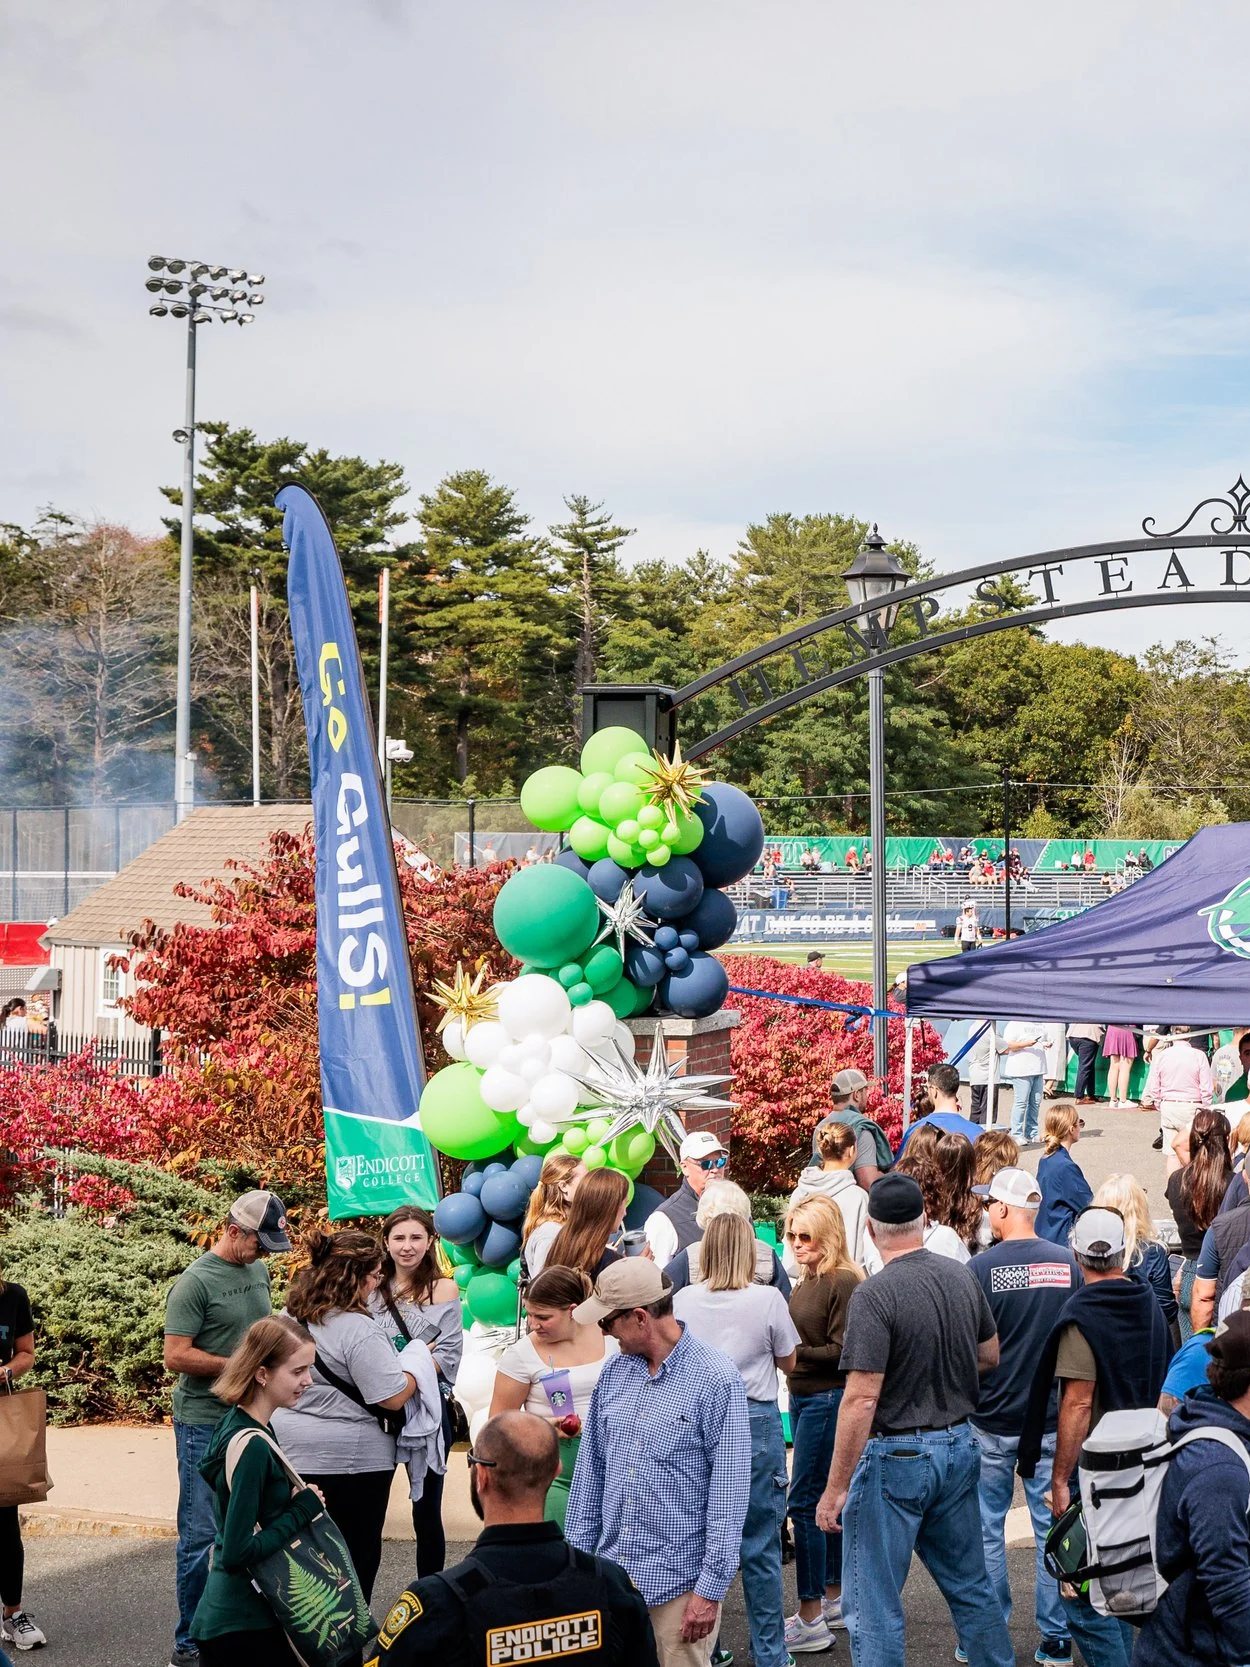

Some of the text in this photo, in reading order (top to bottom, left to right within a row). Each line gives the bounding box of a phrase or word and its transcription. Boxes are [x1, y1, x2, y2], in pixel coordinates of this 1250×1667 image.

[356, 1154, 425, 1176] ENDICOTT
[363, 1173, 420, 1187] COLLEGE
[491, 1614, 597, 1649] ENDICOTT
[491, 1631, 598, 1665] POLICE
